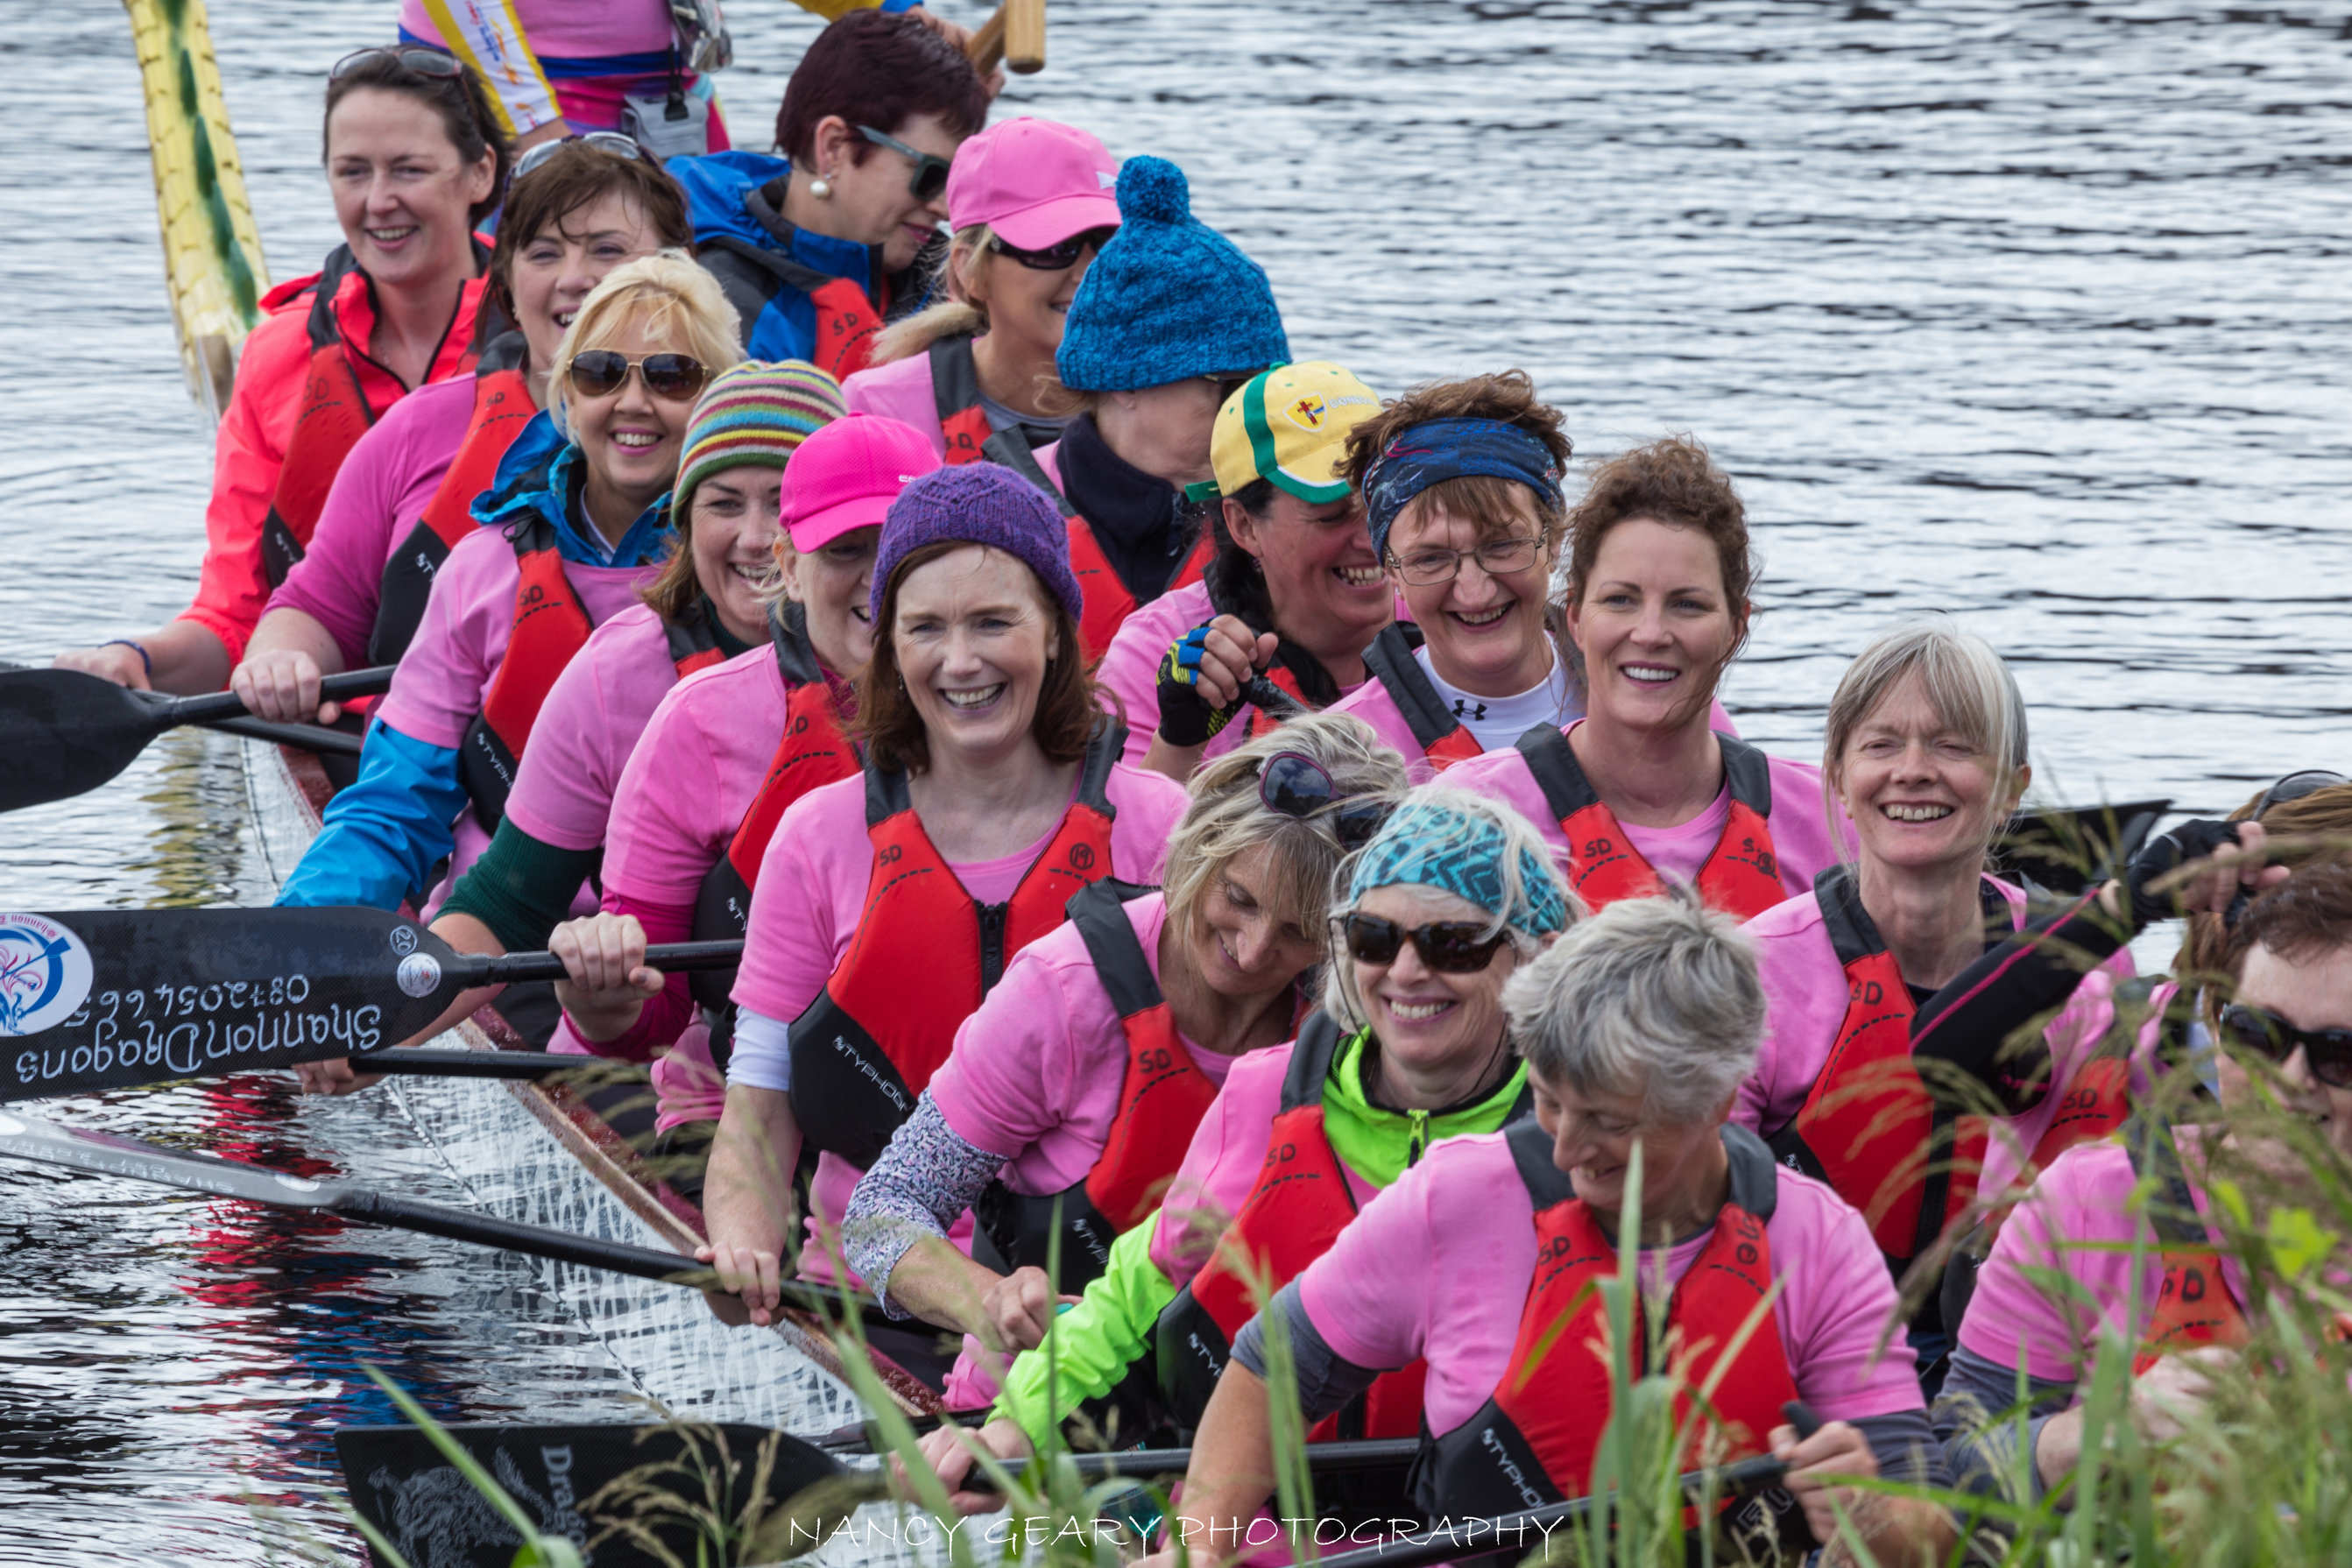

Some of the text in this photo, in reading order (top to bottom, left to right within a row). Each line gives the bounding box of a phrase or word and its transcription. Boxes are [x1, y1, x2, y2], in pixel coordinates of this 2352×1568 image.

[832, 313, 858, 336] SD
[519, 585, 544, 606] SD
[879, 844, 902, 867] SD
[1585, 838, 1612, 858] SD
[1851, 980, 1883, 1006] SD
[1139, 1049, 1170, 1073] SD
[2062, 1088, 2098, 1110] SD
[1266, 1143, 1296, 1167] SD
[1538, 1236, 1570, 1265] SD
